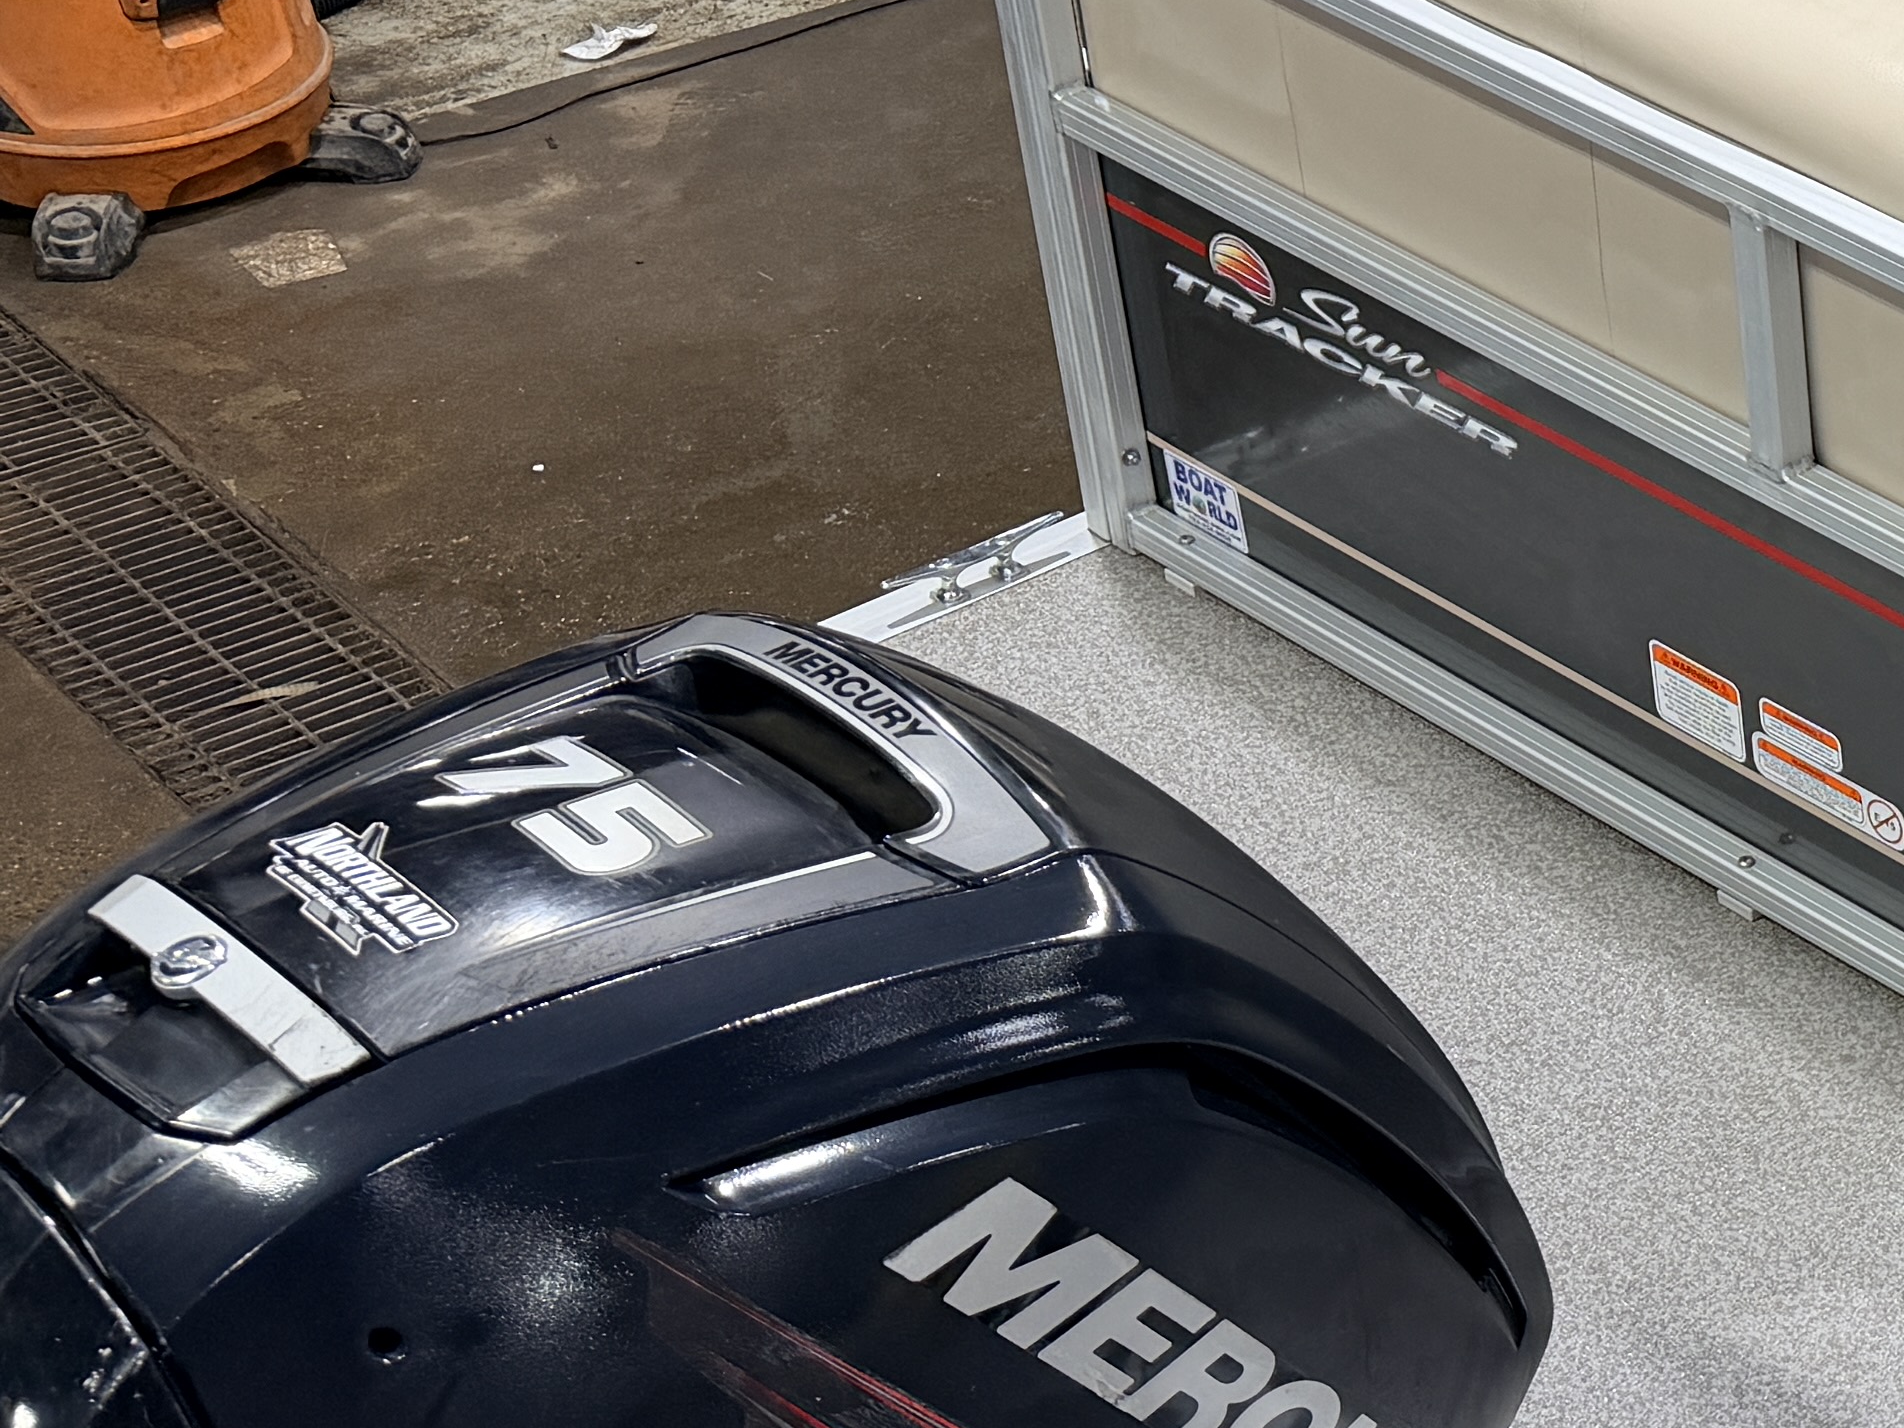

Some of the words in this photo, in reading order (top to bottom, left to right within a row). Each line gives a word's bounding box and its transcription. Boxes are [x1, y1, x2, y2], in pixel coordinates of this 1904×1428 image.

[1165, 262, 1518, 459] TRACKER
[1282, 288, 1431, 378] Sun
[1173, 460, 1227, 506] BOAT
[763, 641, 938, 740] MERCURY
[434, 735, 714, 876] 75
[285, 827, 453, 936] NORTHLAND
[294, 858, 339, 887] AUTO
[344, 894, 415, 946] MARINE
